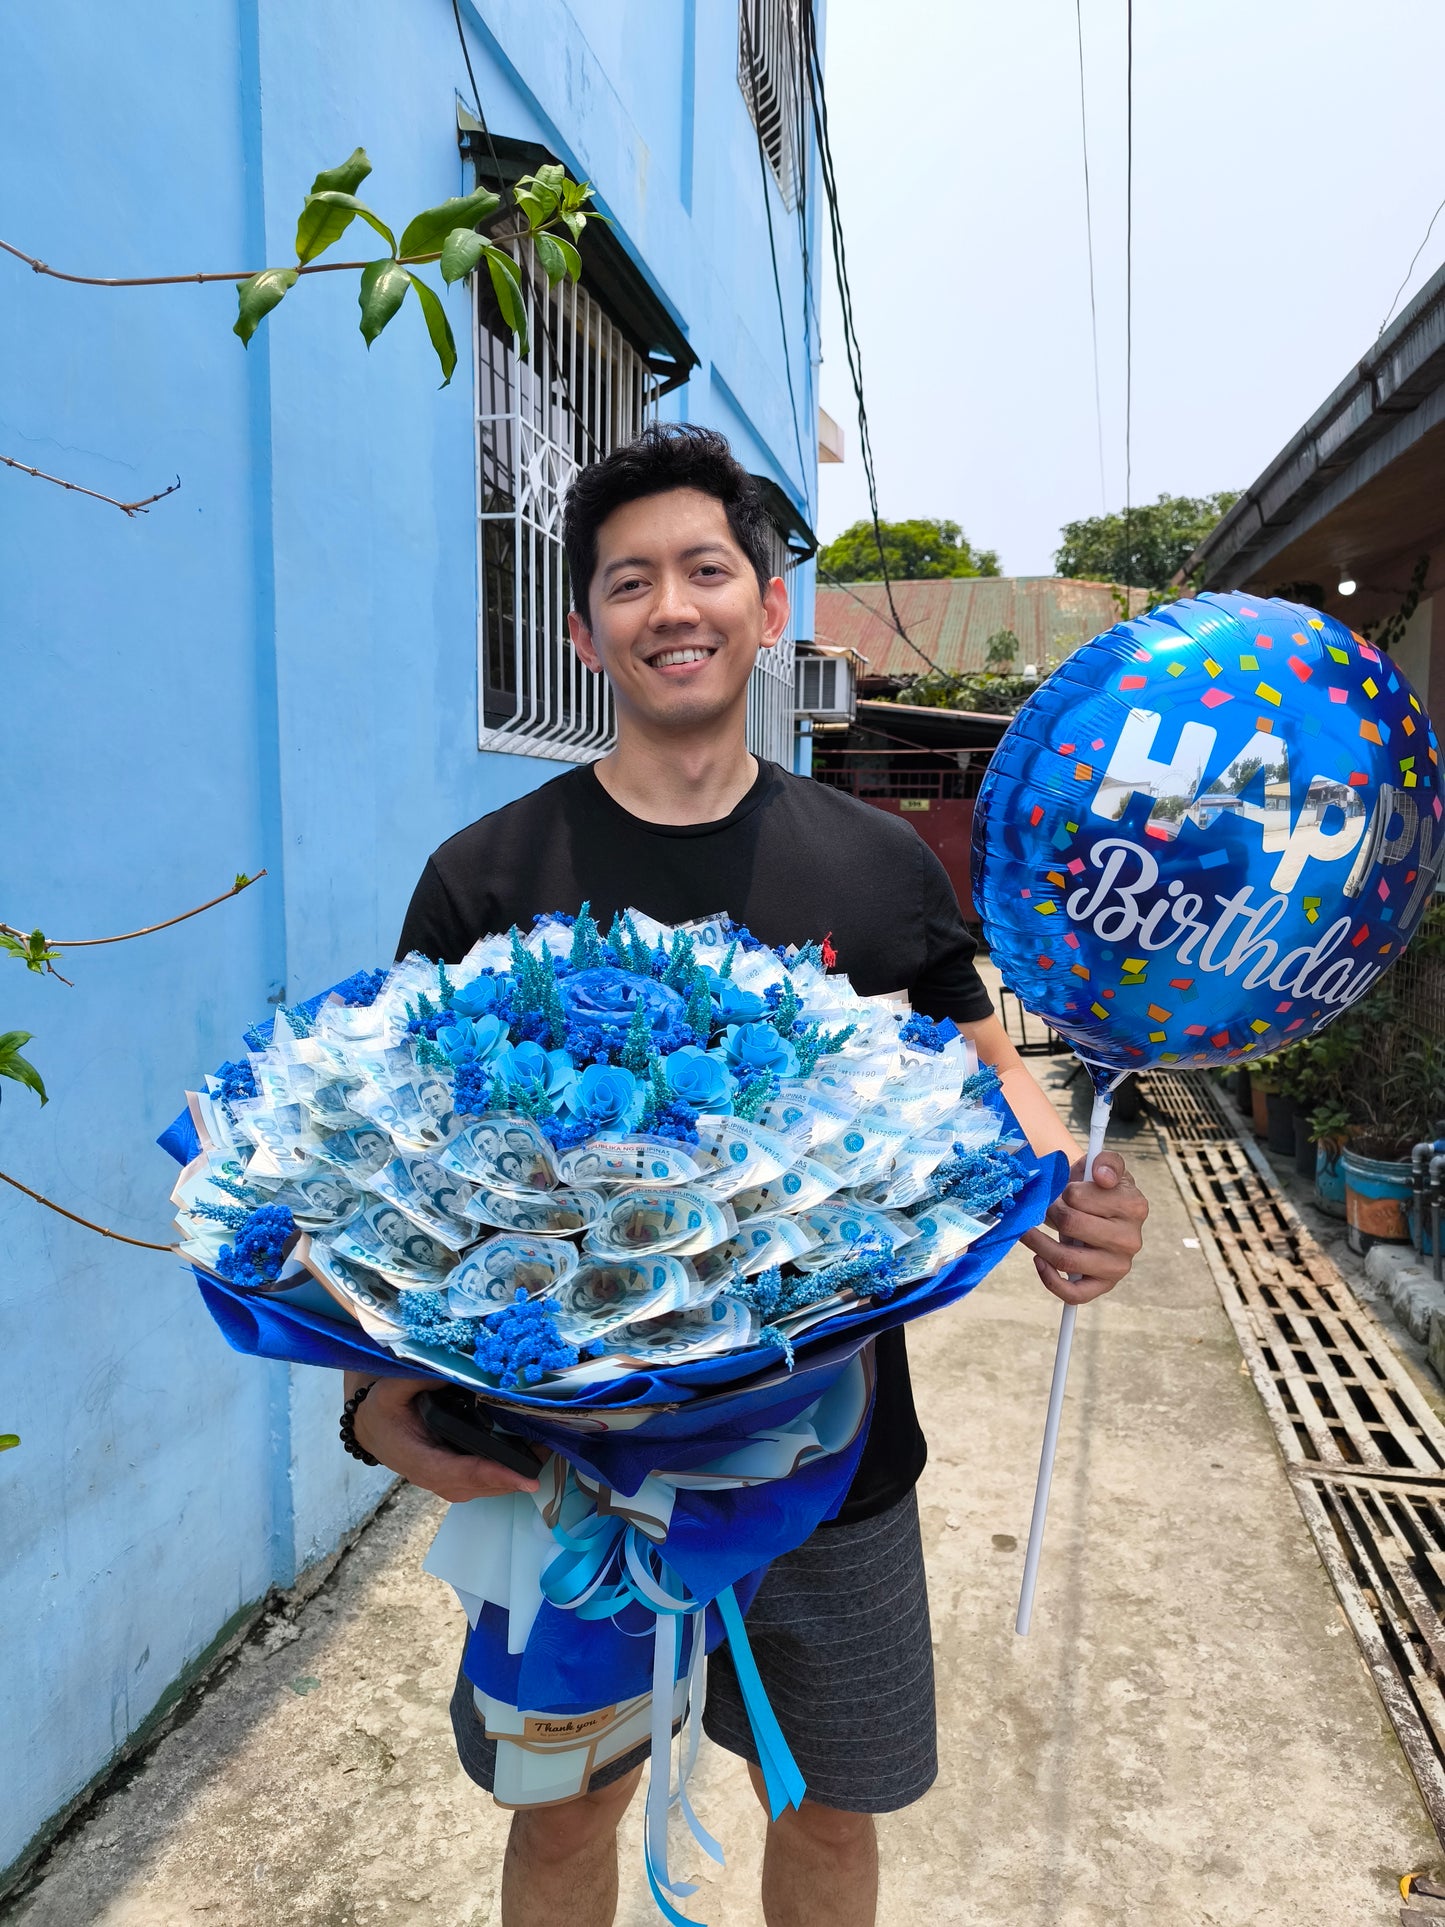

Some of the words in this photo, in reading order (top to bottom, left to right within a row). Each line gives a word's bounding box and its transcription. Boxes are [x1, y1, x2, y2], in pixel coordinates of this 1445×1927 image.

[1066, 838, 1381, 1031] Birthday
[535, 1721, 574, 1733] Thank
[576, 1719, 598, 1733] you
